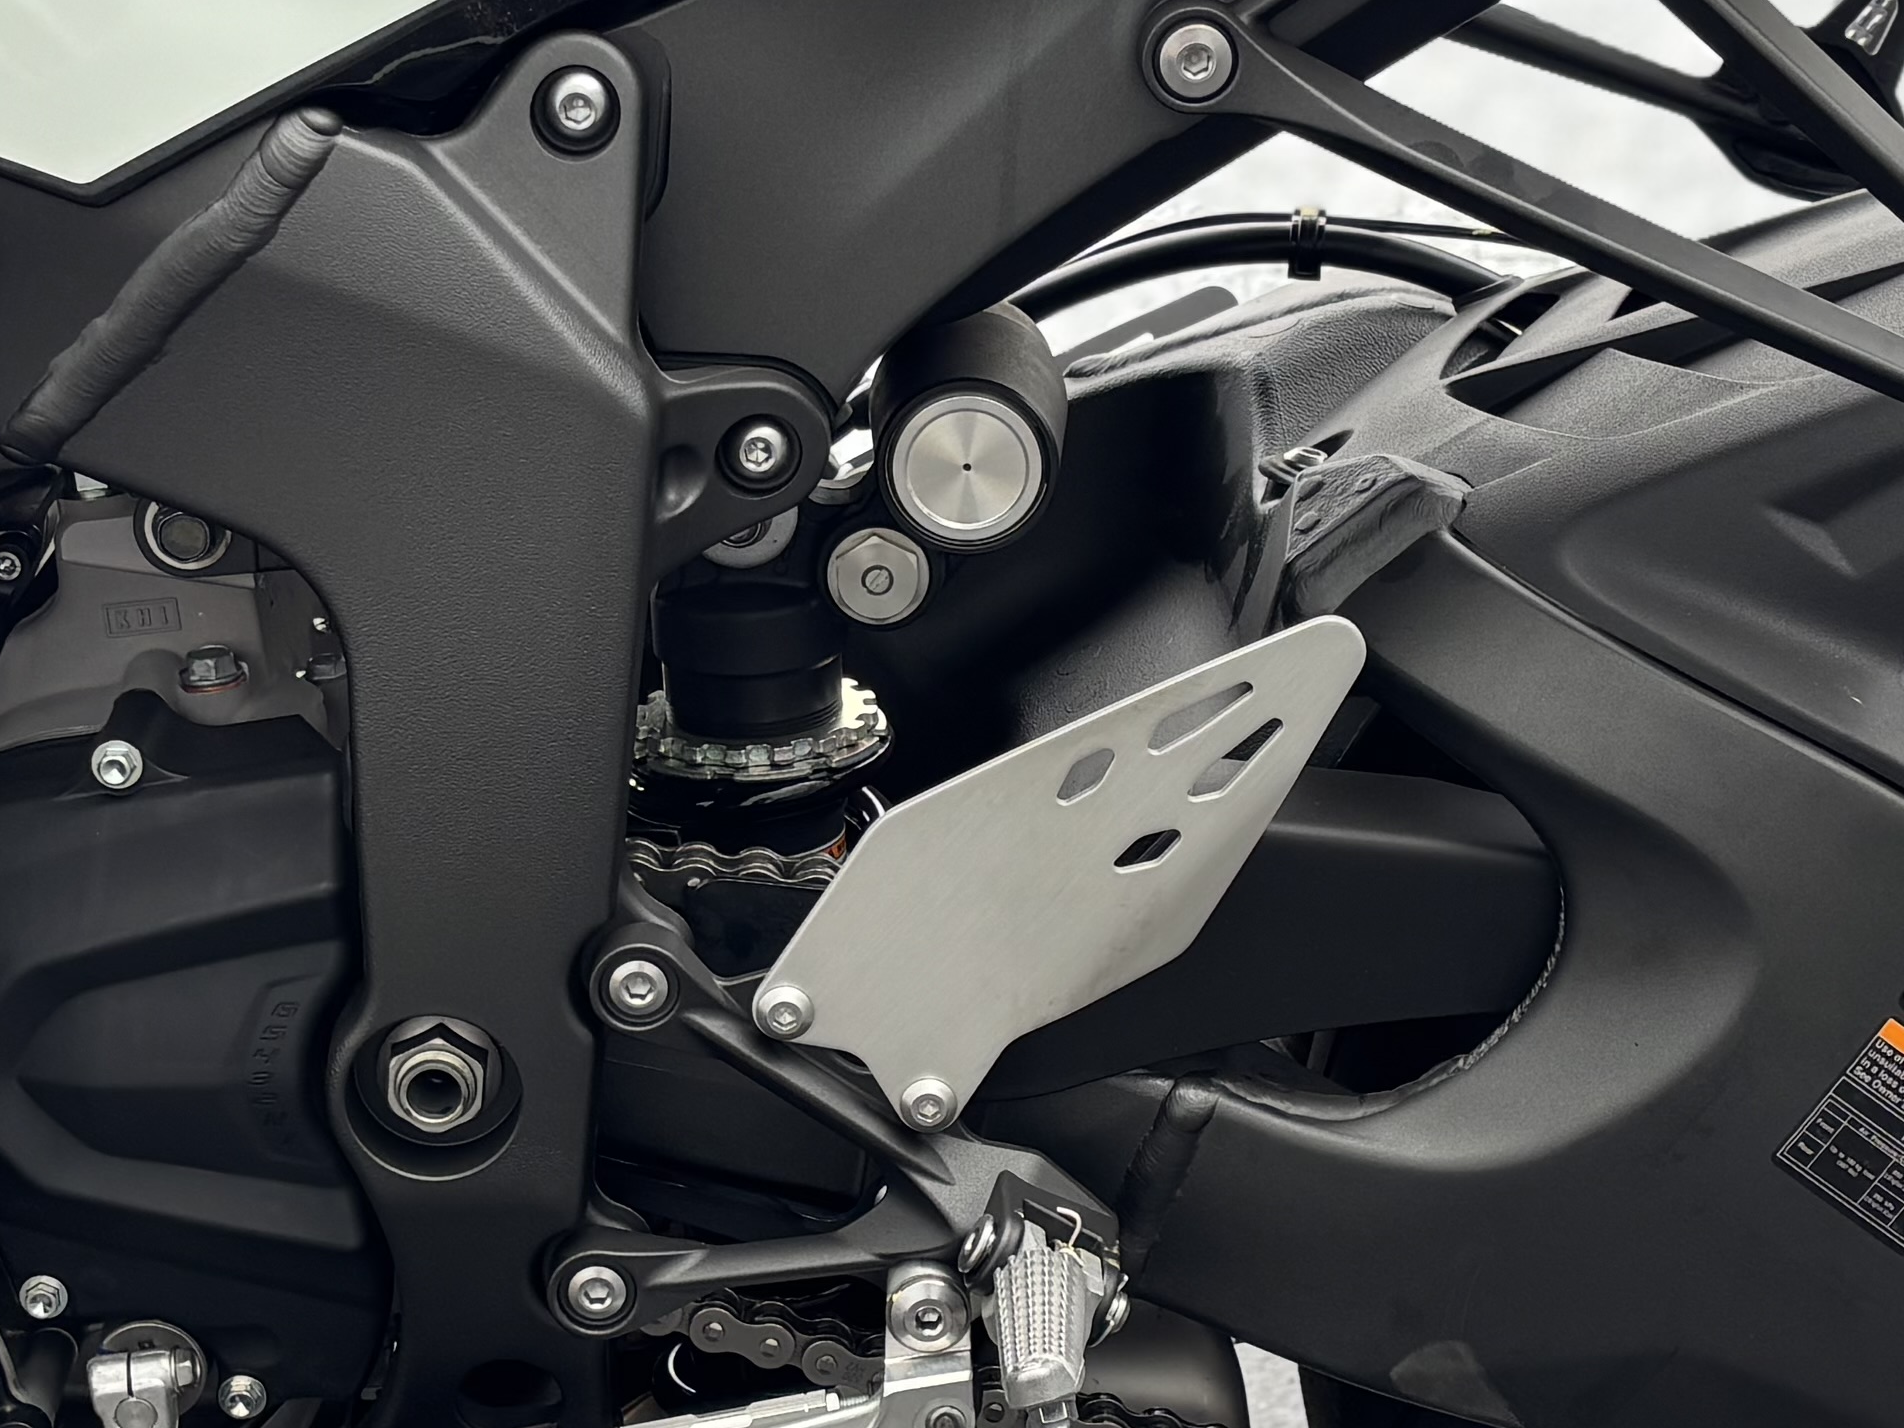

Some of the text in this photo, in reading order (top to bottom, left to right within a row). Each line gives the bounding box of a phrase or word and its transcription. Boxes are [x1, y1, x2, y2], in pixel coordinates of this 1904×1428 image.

[1872, 1038, 1896, 1058] Use
[1851, 1065, 1874, 1084] See
[1858, 1056, 1873, 1069] in
[1868, 1065, 1879, 1075] a
[1876, 1068, 1900, 1089] loss
